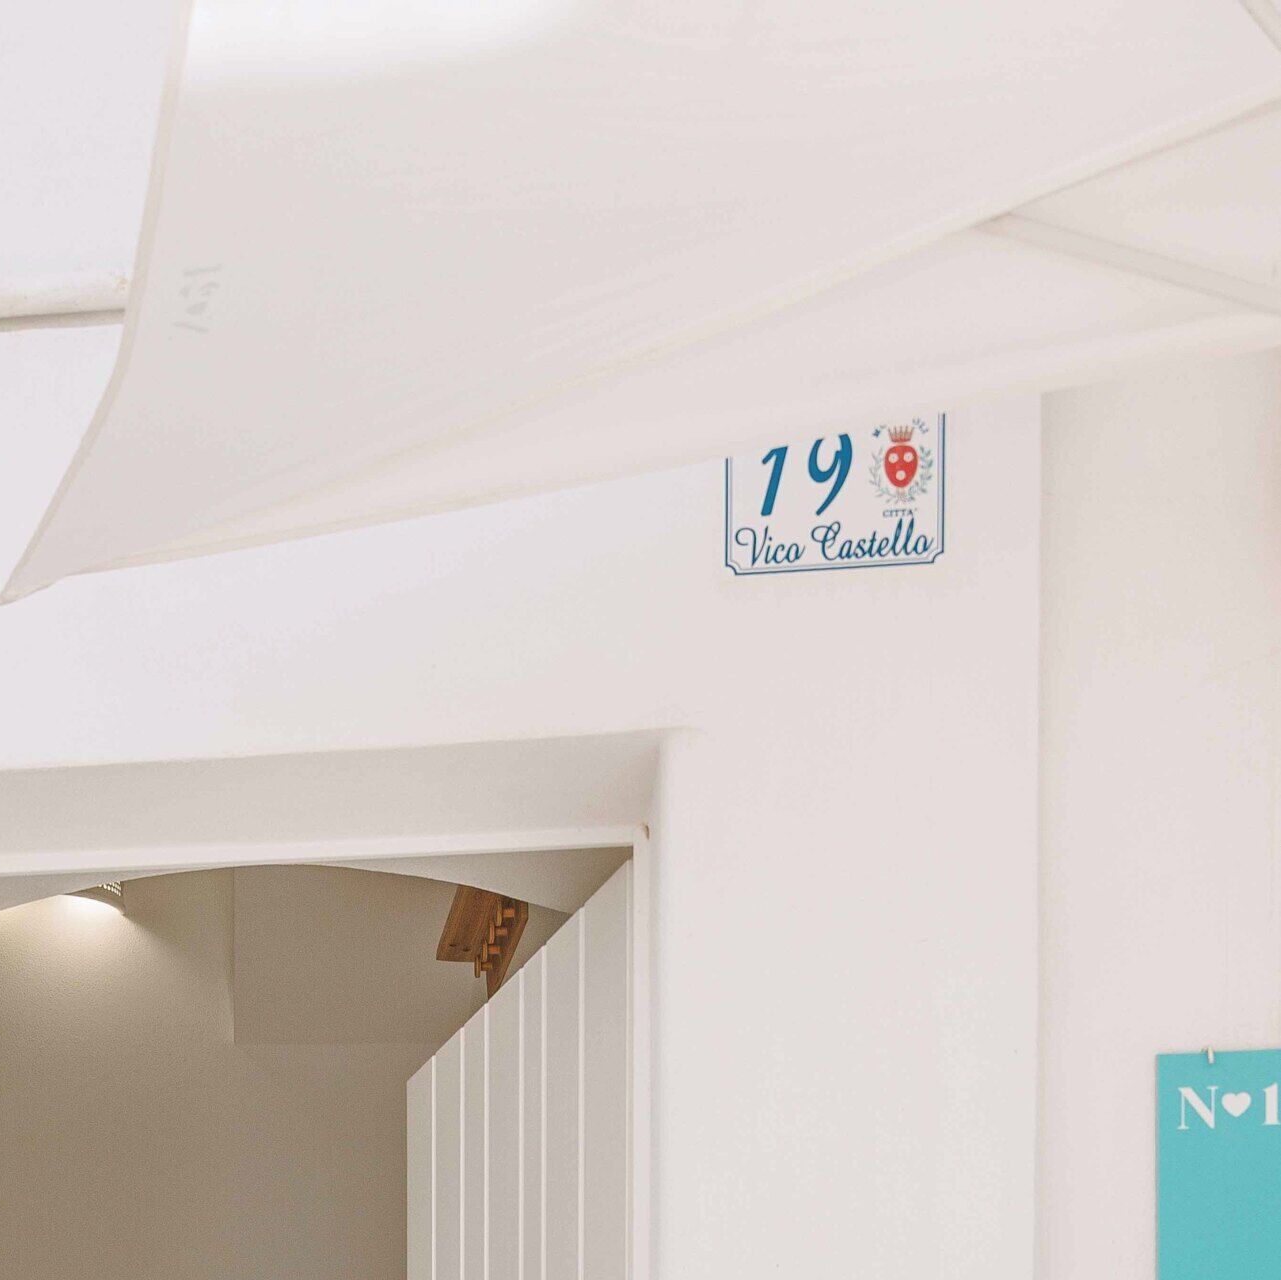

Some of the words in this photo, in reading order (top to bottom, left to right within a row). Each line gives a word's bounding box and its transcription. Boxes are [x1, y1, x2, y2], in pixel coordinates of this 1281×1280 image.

[761, 433, 853, 516] 19
[735, 525, 806, 566] Vico
[811, 517, 935, 561] Castello
